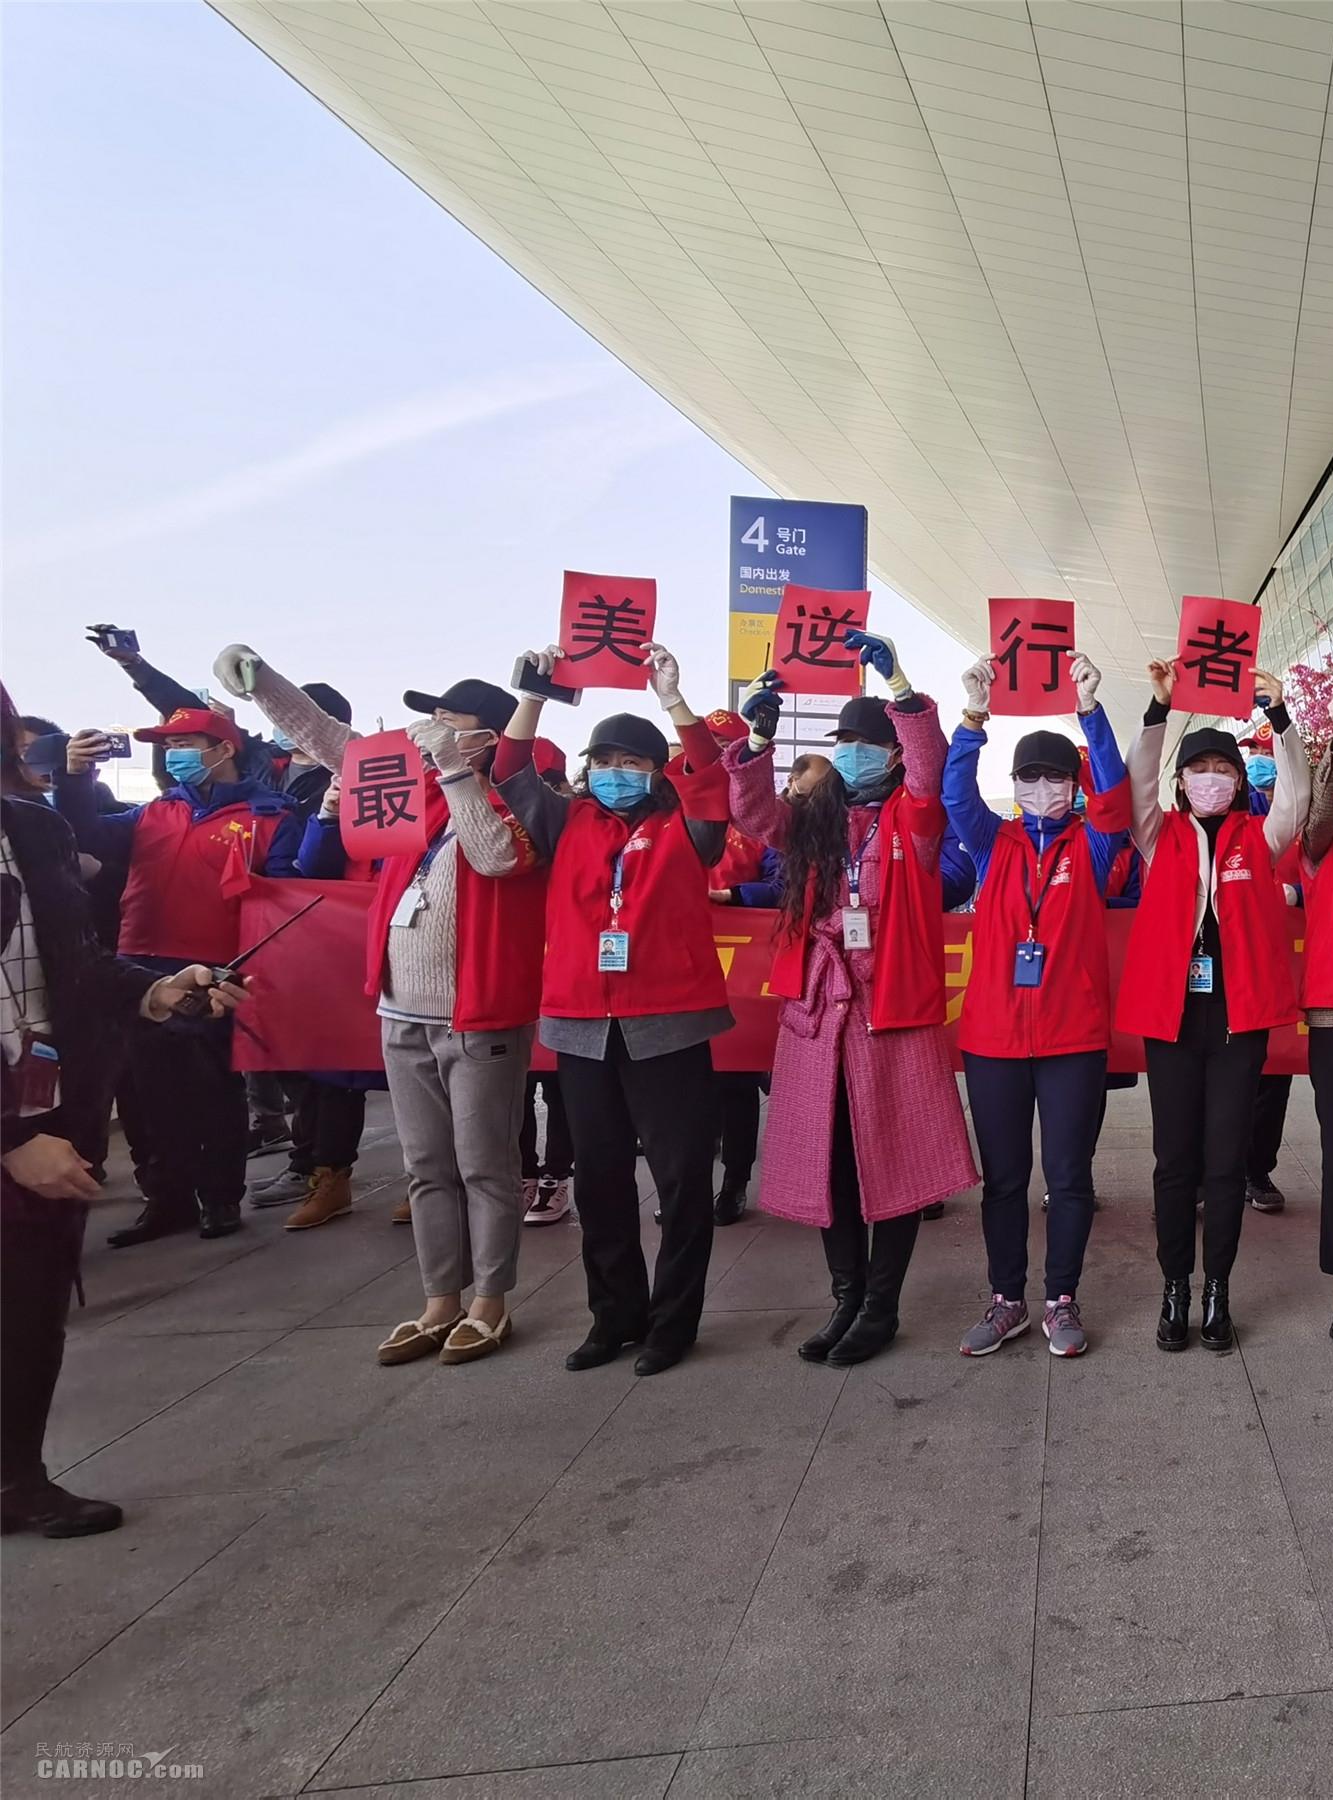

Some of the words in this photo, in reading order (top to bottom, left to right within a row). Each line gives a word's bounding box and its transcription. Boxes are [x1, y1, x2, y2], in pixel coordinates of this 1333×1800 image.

[741, 516, 769, 553] 4
[776, 527, 806, 544] 号门
[776, 543, 806, 556] Gate
[740, 566, 791, 581] 国内出发
[740, 583, 785, 597] Domesti
[569, 594, 647, 667] 美
[780, 604, 863, 669] 逆
[998, 617, 1074, 693] 行
[1183, 619, 1253, 693] 者
[350, 753, 418, 830] 最
